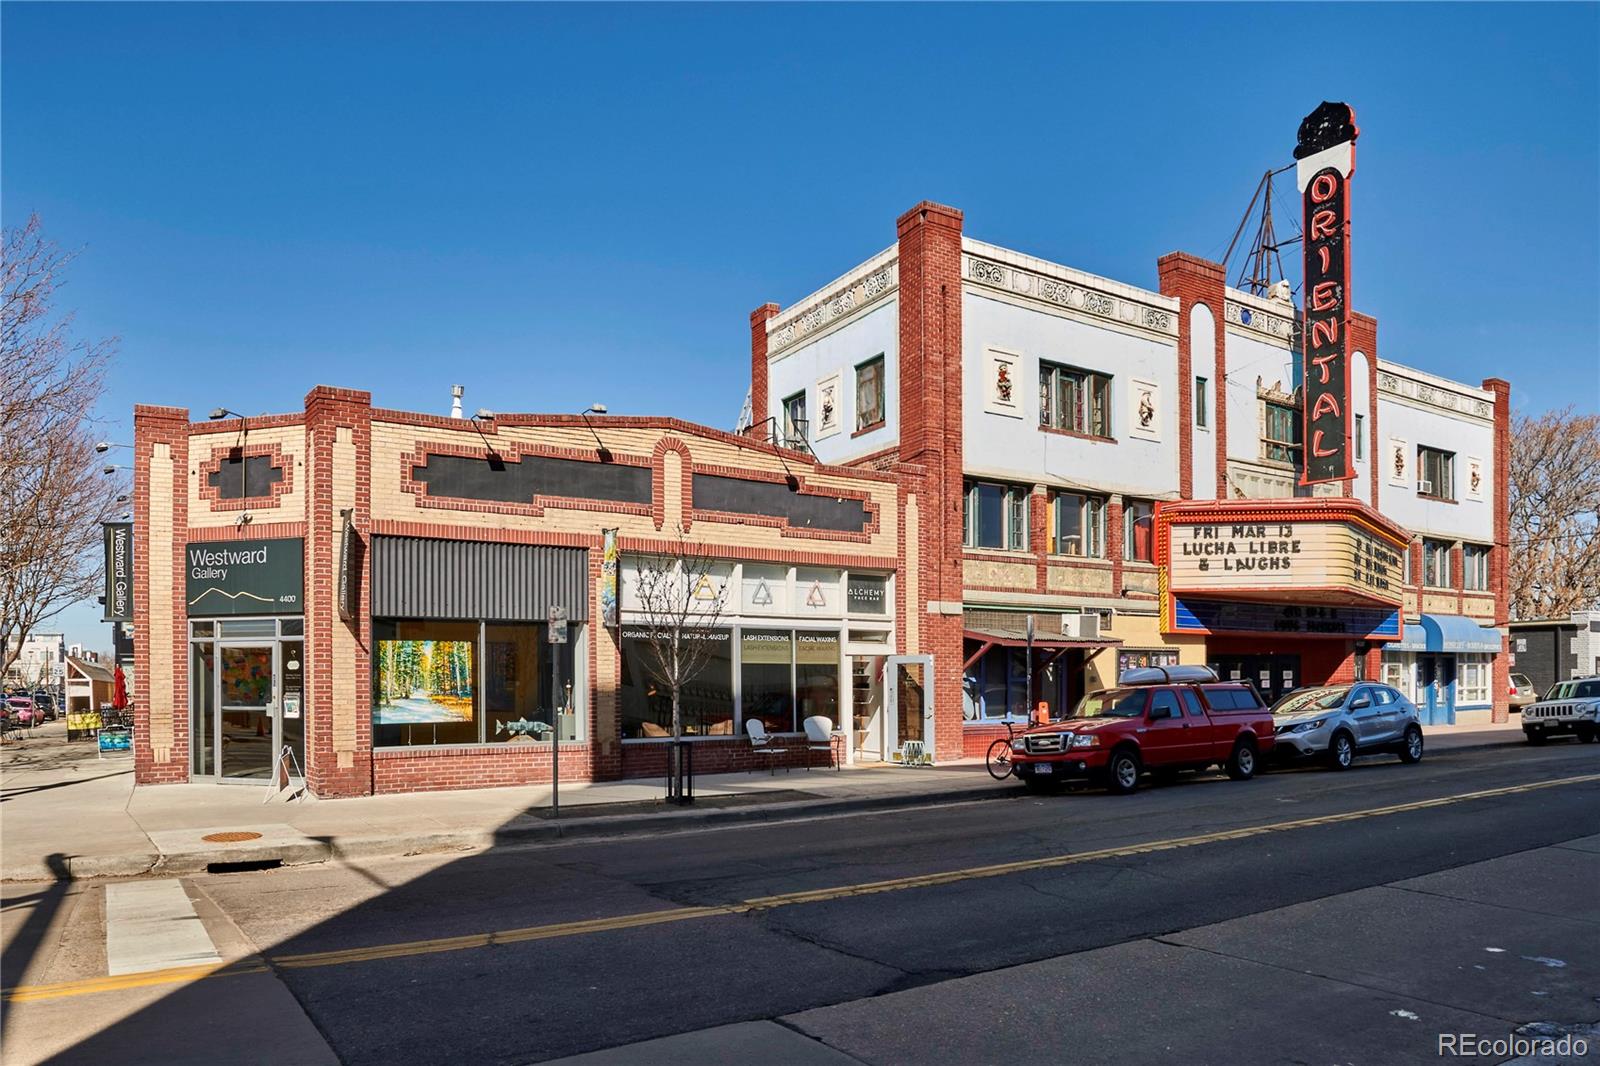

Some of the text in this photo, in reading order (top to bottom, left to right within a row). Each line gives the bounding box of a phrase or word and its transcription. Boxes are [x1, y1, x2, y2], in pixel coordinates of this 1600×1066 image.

[1311, 173, 1340, 457] ORIENTAL
[1193, 525, 1293, 539] FRI MAR 13
[1183, 540, 1301, 556] LUCHA LIBRE
[190, 546, 267, 566] Westward
[1199, 556, 1291, 571] & LAUGHS
[114, 528, 127, 616] Westward Gallery
[191, 567, 228, 581] Gallery
[279, 595, 296, 603] 4400
[848, 588, 885, 596] ALCHEMY
